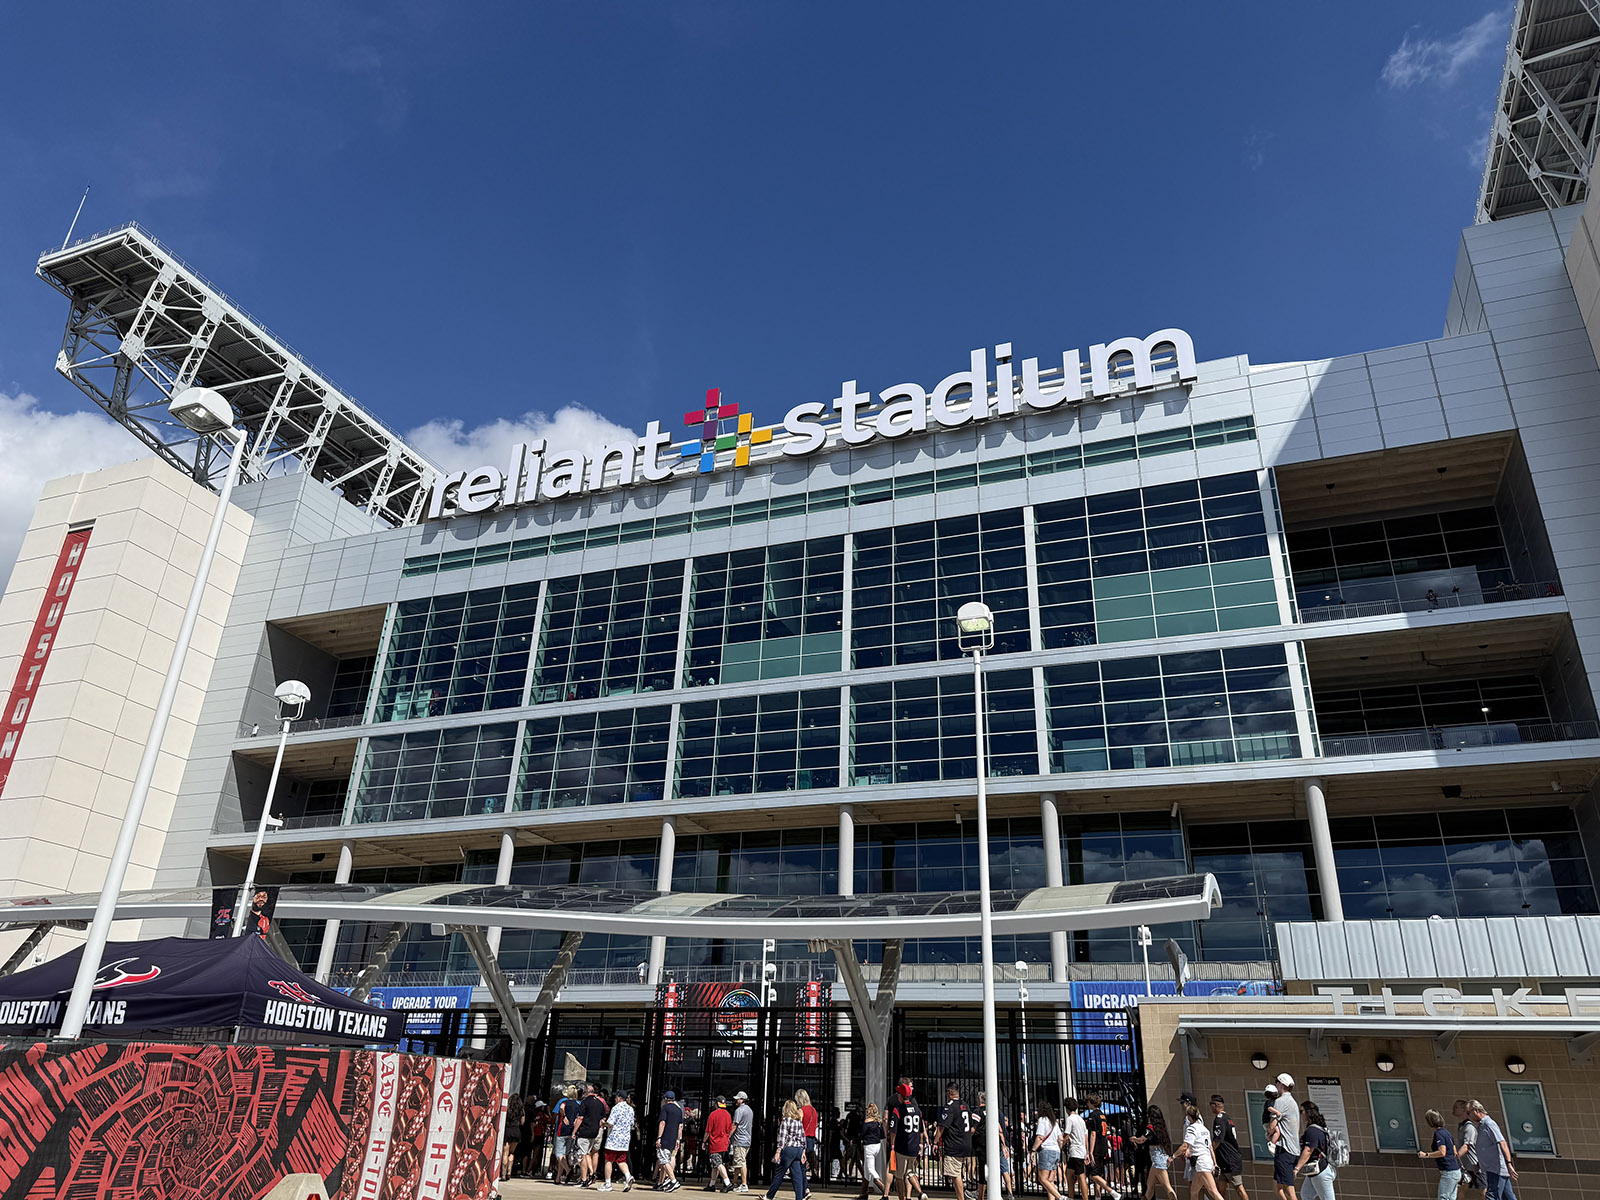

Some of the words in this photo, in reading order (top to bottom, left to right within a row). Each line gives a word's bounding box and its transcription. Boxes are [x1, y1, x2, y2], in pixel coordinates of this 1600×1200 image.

[428, 420, 674, 519] reliant
[781, 328, 1198, 455] stadium
[0, 542, 84, 759] HOUSTON
[0, 1001, 61, 1024] OUSTON
[392, 996, 432, 1009] UPGRADE
[434, 996, 457, 1009] YOUR
[1084, 994, 1146, 1009] UPGRAD
[263, 1000, 338, 1032] HOUSTON
[337, 1011, 388, 1039] TEXANS
[732, 1049, 752, 1058] TIM
[904, 1115, 920, 1133] 99
[422, 1143, 448, 1200] H-T
